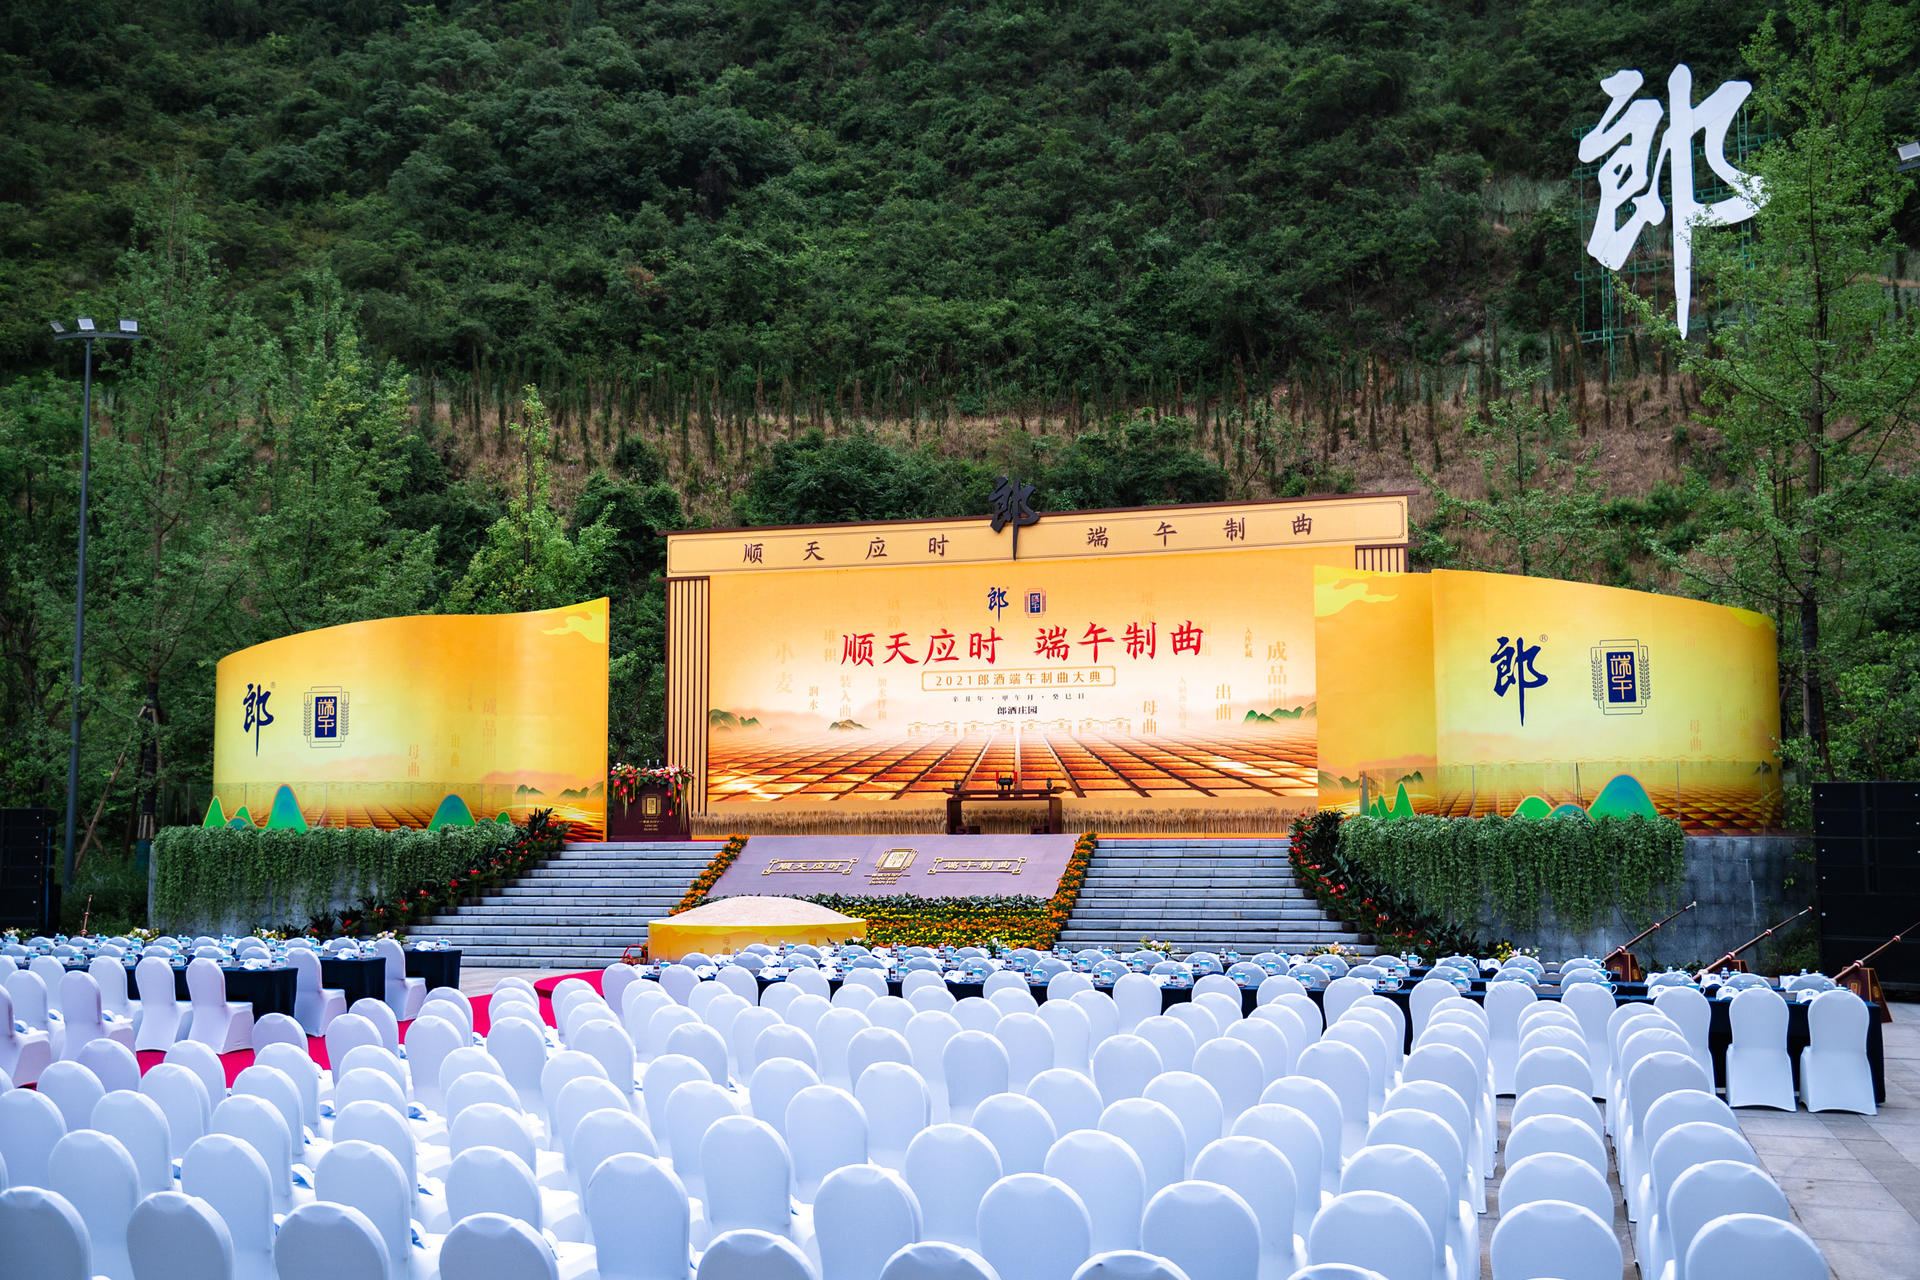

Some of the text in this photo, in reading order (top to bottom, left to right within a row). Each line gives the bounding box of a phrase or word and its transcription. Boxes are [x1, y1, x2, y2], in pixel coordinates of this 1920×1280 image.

[1577, 62, 1772, 340] 郎
[742, 512, 1313, 565] 顺天应时 端午制曲
[989, 477, 1041, 561] 郎
[987, 586, 1009, 622] 郎
[841, 626, 1004, 667] 顺天应时
[1033, 619, 1204, 664] 端午制曲
[935, 670, 1101, 687] 2021郎酒端午制曲大典
[1490, 636, 1549, 728] 郎
[243, 683, 275, 757] 郎
[997, 706, 1038, 715] 郎酒庄园
